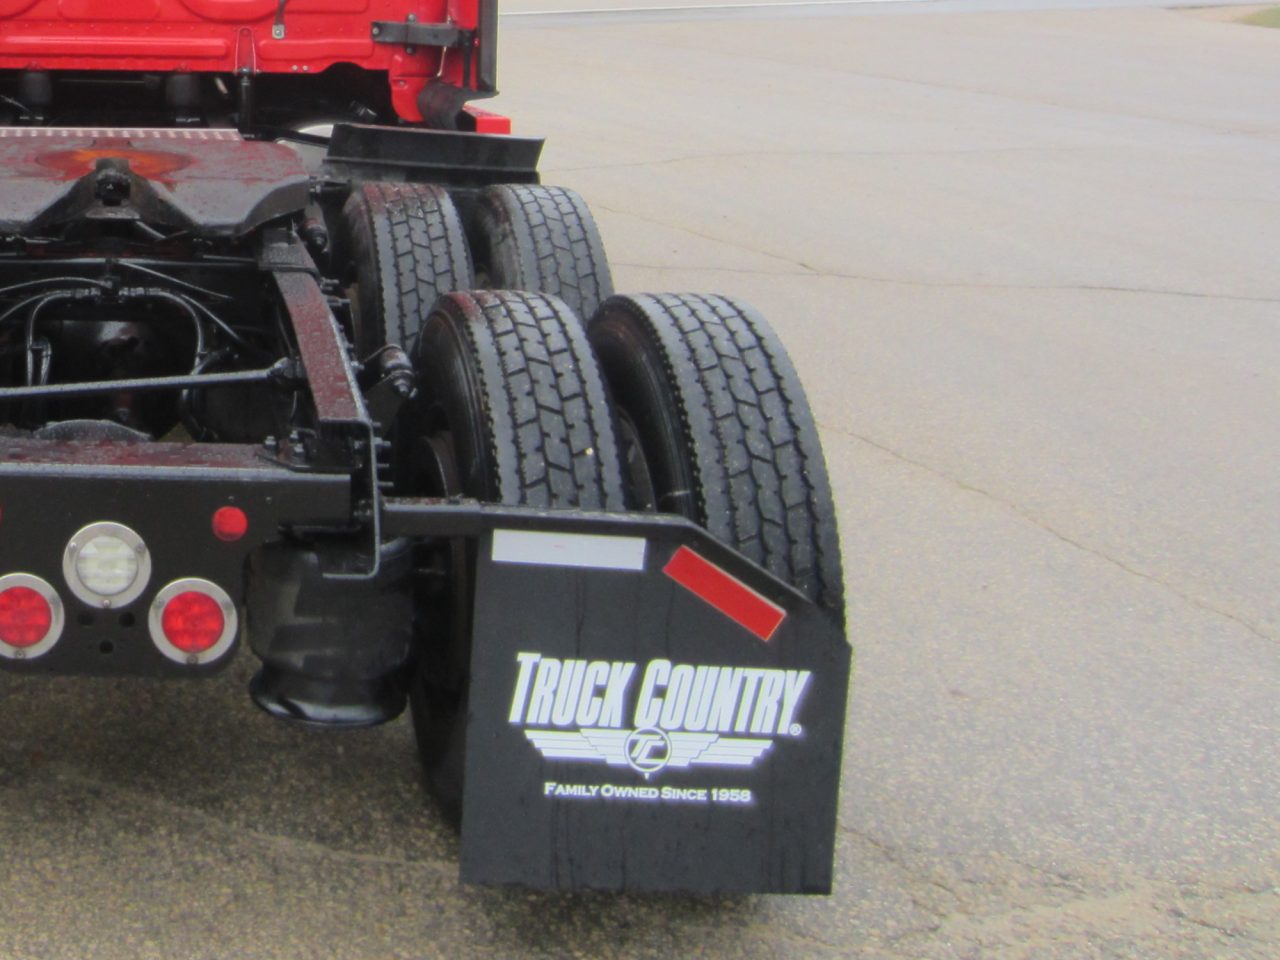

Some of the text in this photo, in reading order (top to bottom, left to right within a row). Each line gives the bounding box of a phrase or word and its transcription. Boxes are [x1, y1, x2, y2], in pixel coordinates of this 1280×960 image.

[509, 652, 636, 728] TRUCK
[544, 782, 751, 802] FAMILY OWNED SINCE 1958
